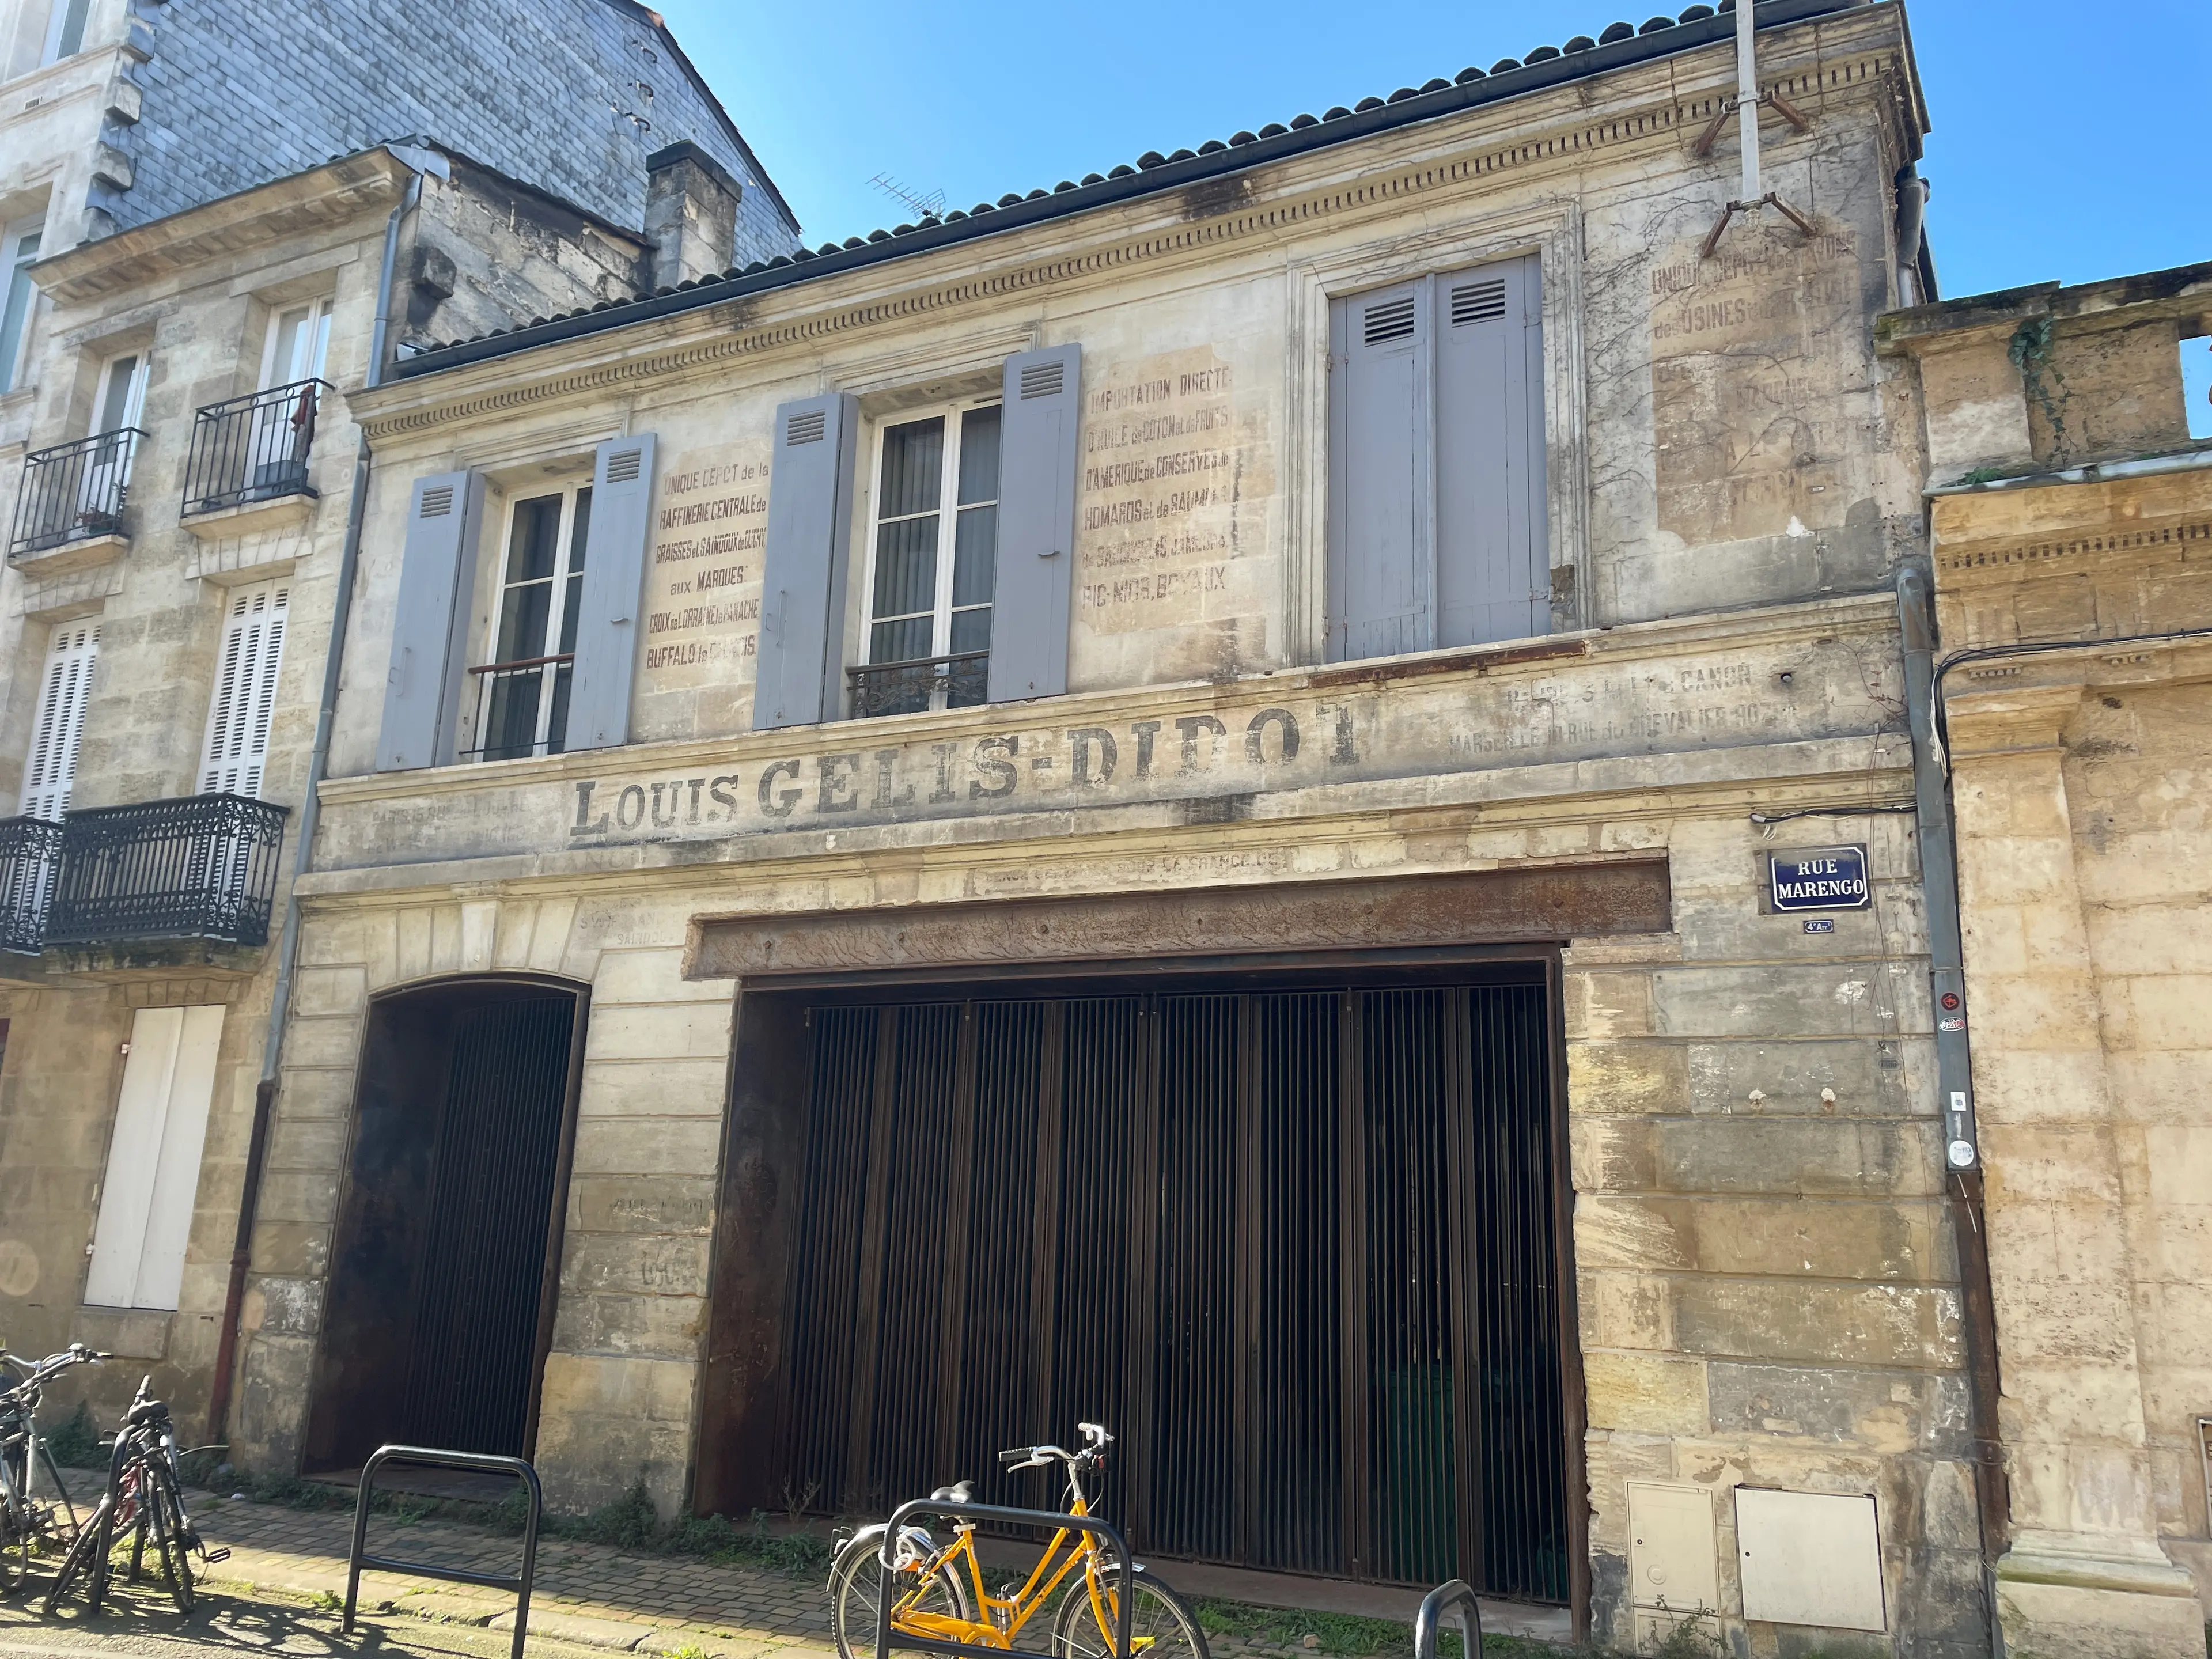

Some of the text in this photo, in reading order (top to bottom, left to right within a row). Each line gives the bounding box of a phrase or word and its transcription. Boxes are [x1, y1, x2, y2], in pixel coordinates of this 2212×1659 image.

[1680, 297, 1747, 335] USINES
[1091, 378, 1171, 414] IMPORTATION
[1143, 415, 1175, 442] COTON
[1195, 404, 1228, 433] FRUITS
[665, 471, 700, 495] UNIQUE
[741, 464, 755, 480] de
[759, 462, 769, 477] la
[660, 493, 766, 530] RAFFINERIE CENTRALE de
[1085, 499, 1142, 531] HOMARDS
[1156, 499, 1169, 519] de
[656, 539, 692, 564] GRAISSES
[692, 540, 700, 558] et
[700, 532, 739, 557] SAINDOUX
[671, 581, 692, 596] aux
[649, 612, 671, 634] CROIX
[570, 774, 740, 836] LOUIS
[1797, 858, 1838, 876] RUE
[1778, 878, 1865, 899] MARENGO
